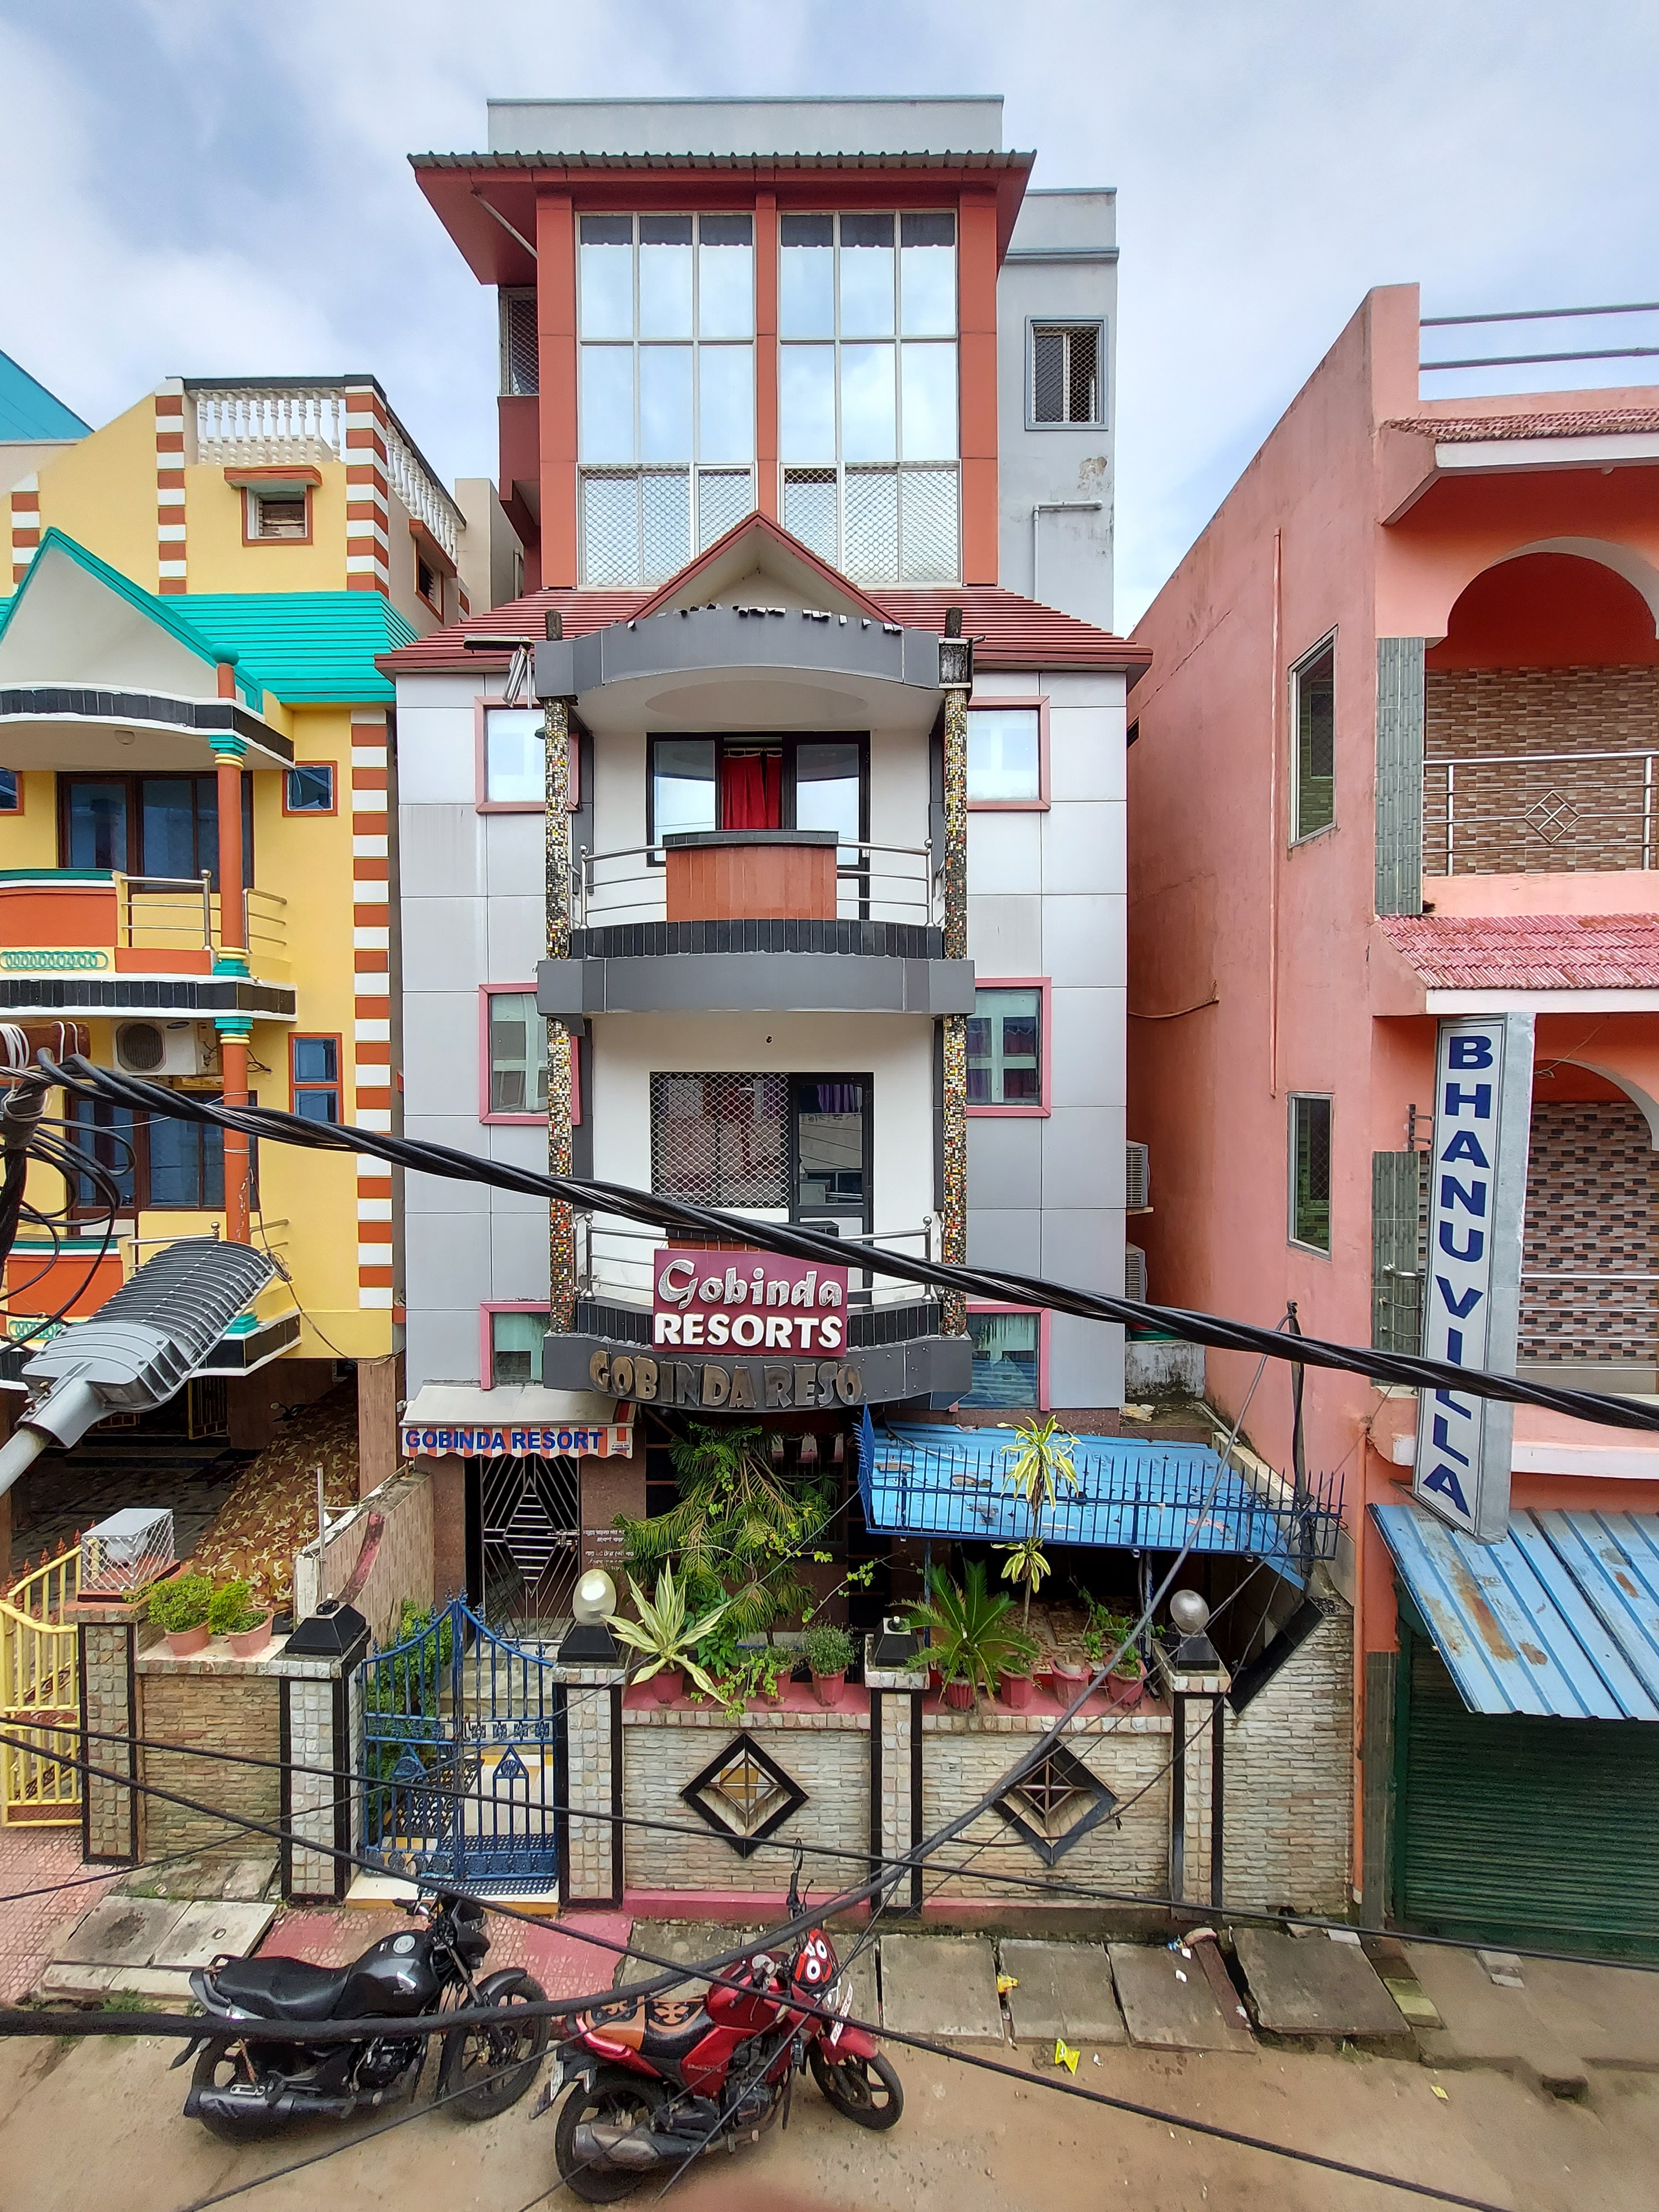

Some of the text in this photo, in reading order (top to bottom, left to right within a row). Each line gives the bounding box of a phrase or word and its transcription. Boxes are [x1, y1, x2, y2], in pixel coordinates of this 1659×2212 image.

[1439, 1035, 1494, 1262] BHANU
[658, 1259, 842, 1310] Gobinda
[655, 1312, 842, 1349] RESORTS
[589, 1350, 863, 1408] GOBINDA RESO
[406, 1430, 505, 1450] GOBINDA
[512, 1431, 603, 1449] RESORT
